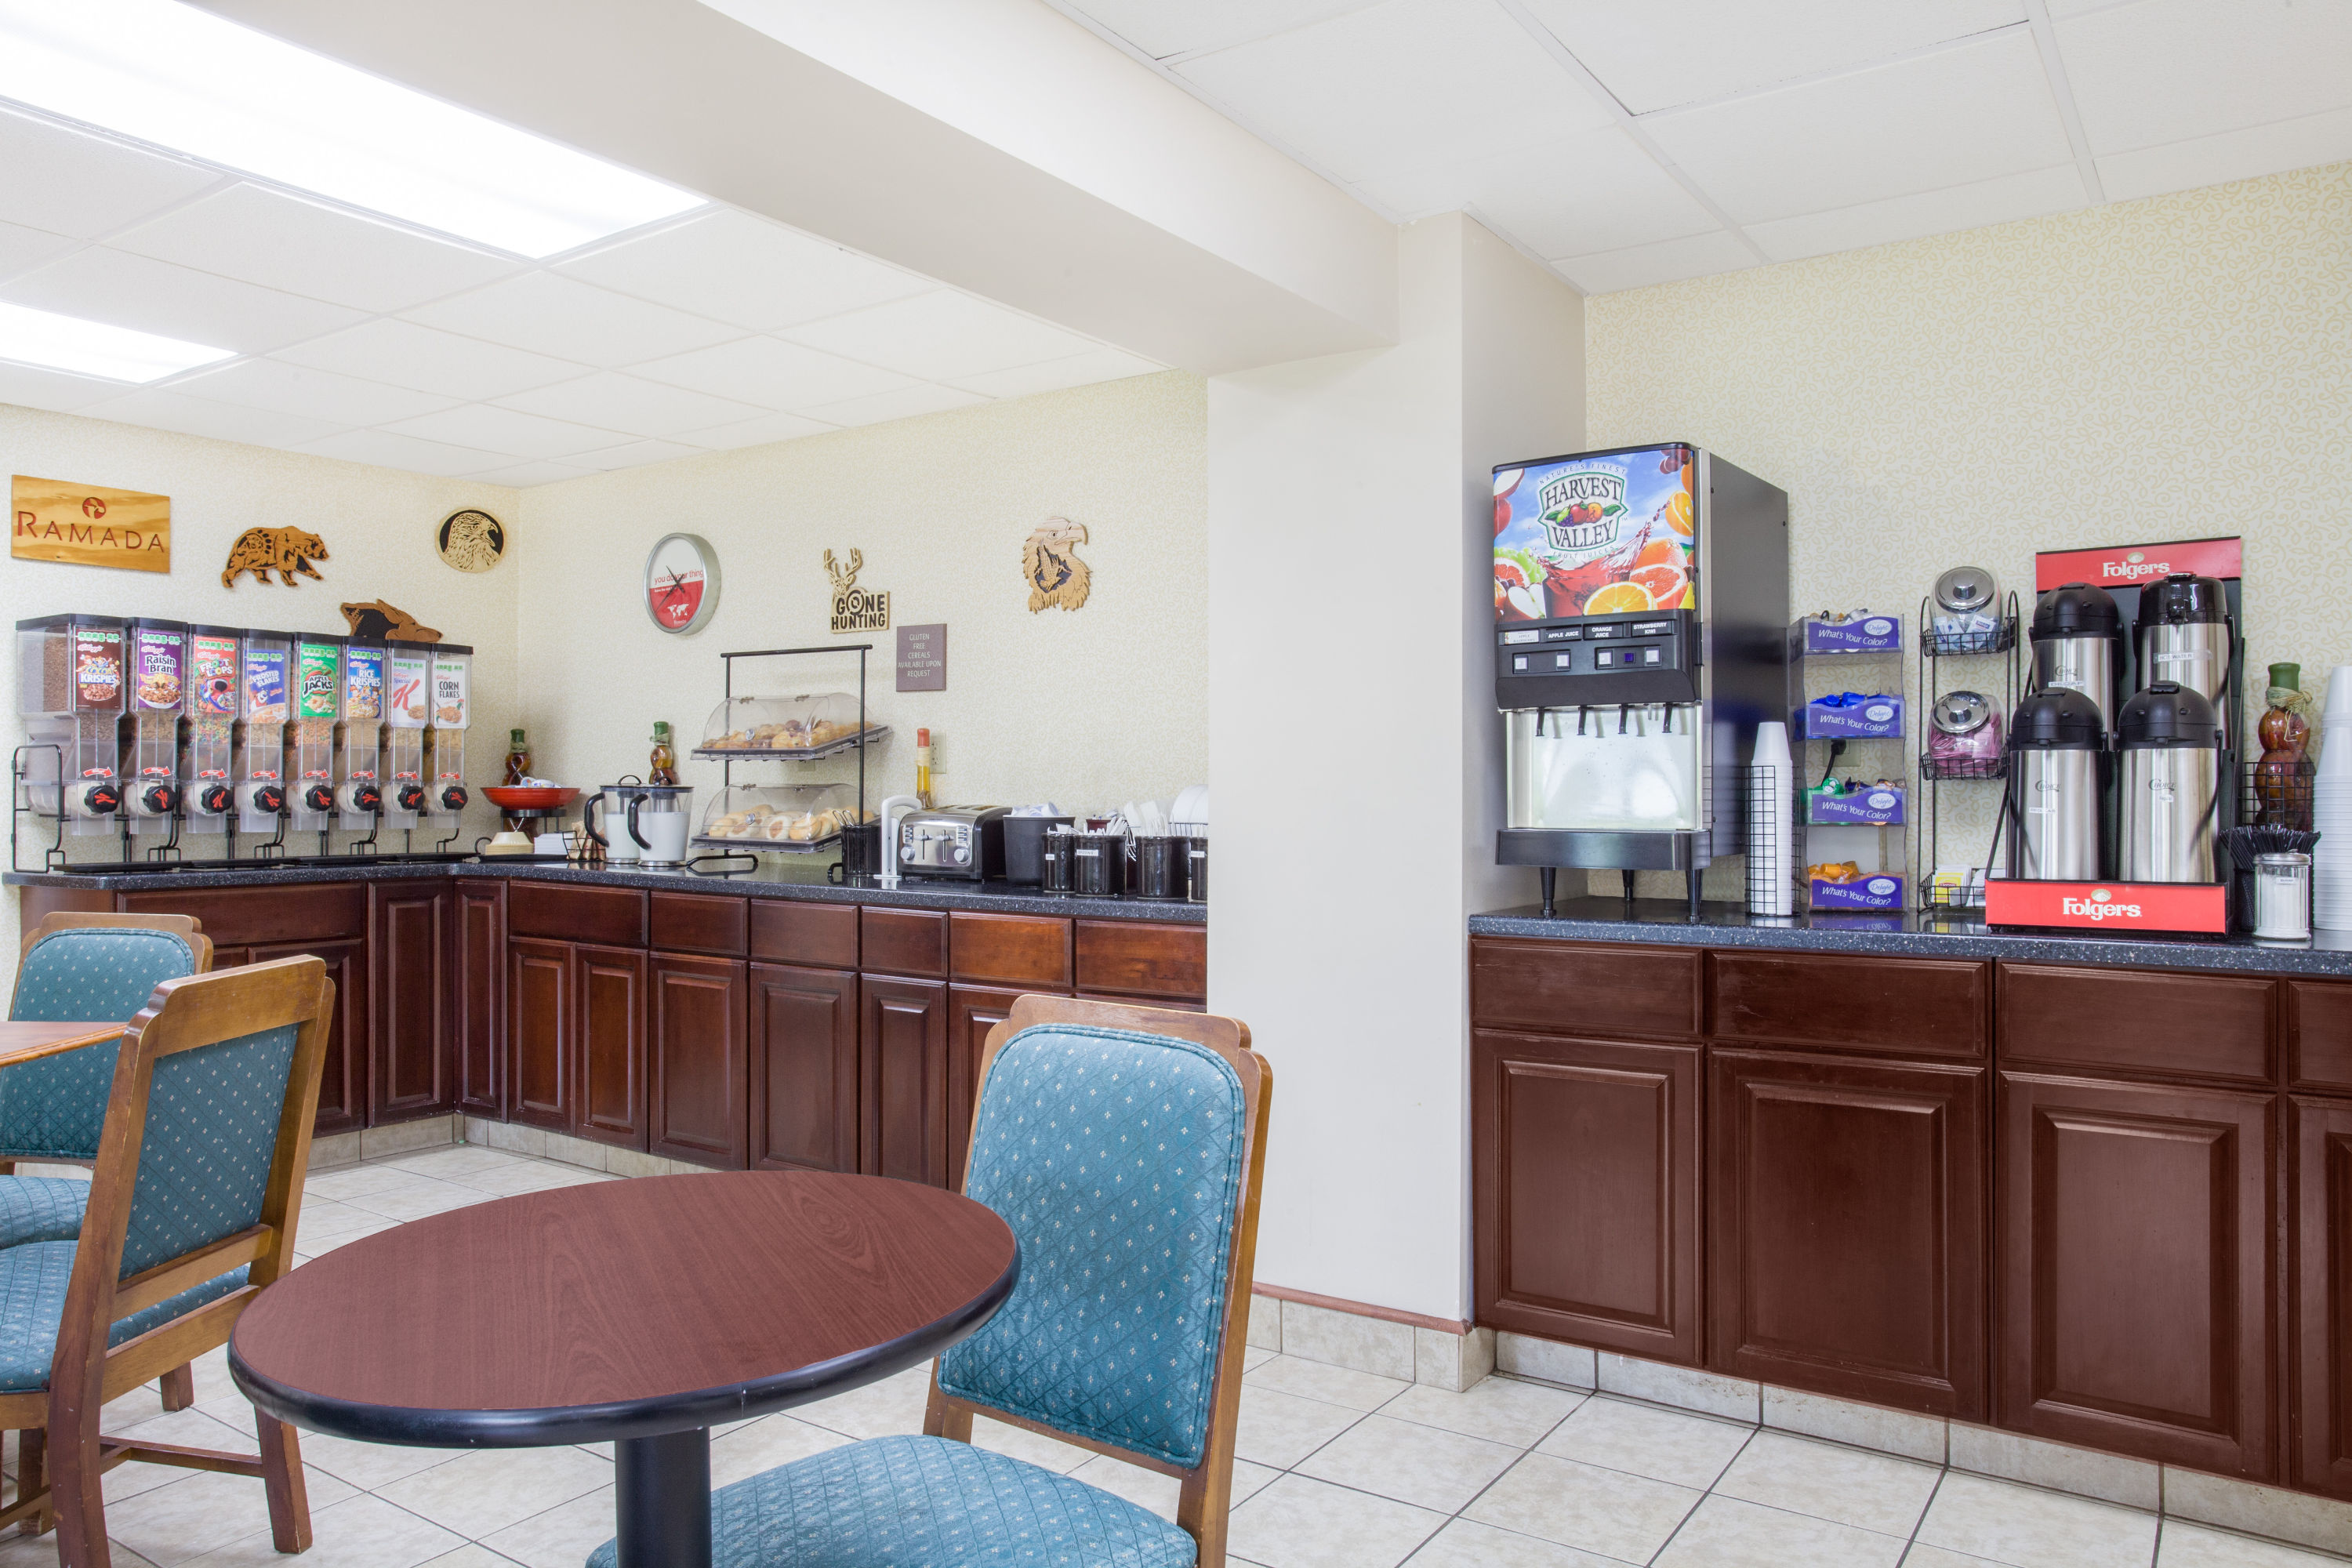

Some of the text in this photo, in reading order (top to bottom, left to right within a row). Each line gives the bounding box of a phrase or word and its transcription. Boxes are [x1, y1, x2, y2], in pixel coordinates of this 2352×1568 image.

[1540, 463, 1626, 485] NATURE'S FINEST
[1544, 477, 1621, 511] HARVEST
[17, 510, 164, 553] RAMADA
[1552, 520, 1613, 548] VALLEY
[689, 569, 703, 578] thing
[2102, 561, 2170, 579] Folgers
[837, 590, 885, 615] GONE
[831, 612, 886, 630] HUNTING
[1867, 624, 1889, 633] Delight
[1818, 629, 1888, 646] What's Your Color?
[146, 654, 176, 666] Raisin
[199, 659, 230, 673] FROOT
[85, 665, 113, 674] COCOA
[150, 665, 172, 673] Bran
[206, 666, 233, 677] LOOPS
[81, 673, 117, 684] KRISPIES
[253, 670, 280, 683] FROSTED
[256, 677, 280, 688] FLAKES
[350, 677, 380, 688] KRISPIES
[303, 681, 333, 698] JACKS
[439, 681, 459, 690] CORN
[393, 679, 420, 710] K
[1868, 710, 1890, 719] Delight
[1820, 715, 1889, 732] What's Your Color?
[2035, 779, 2061, 792] CHOICE
[2148, 779, 2176, 791] CHOICE
[1869, 797, 1893, 806] Delight
[1822, 801, 1892, 820] What's Your Color?
[1870, 882, 1893, 892] Delight
[1822, 887, 1892, 906] What's Your Color?
[2063, 897, 2142, 920] Folgers
